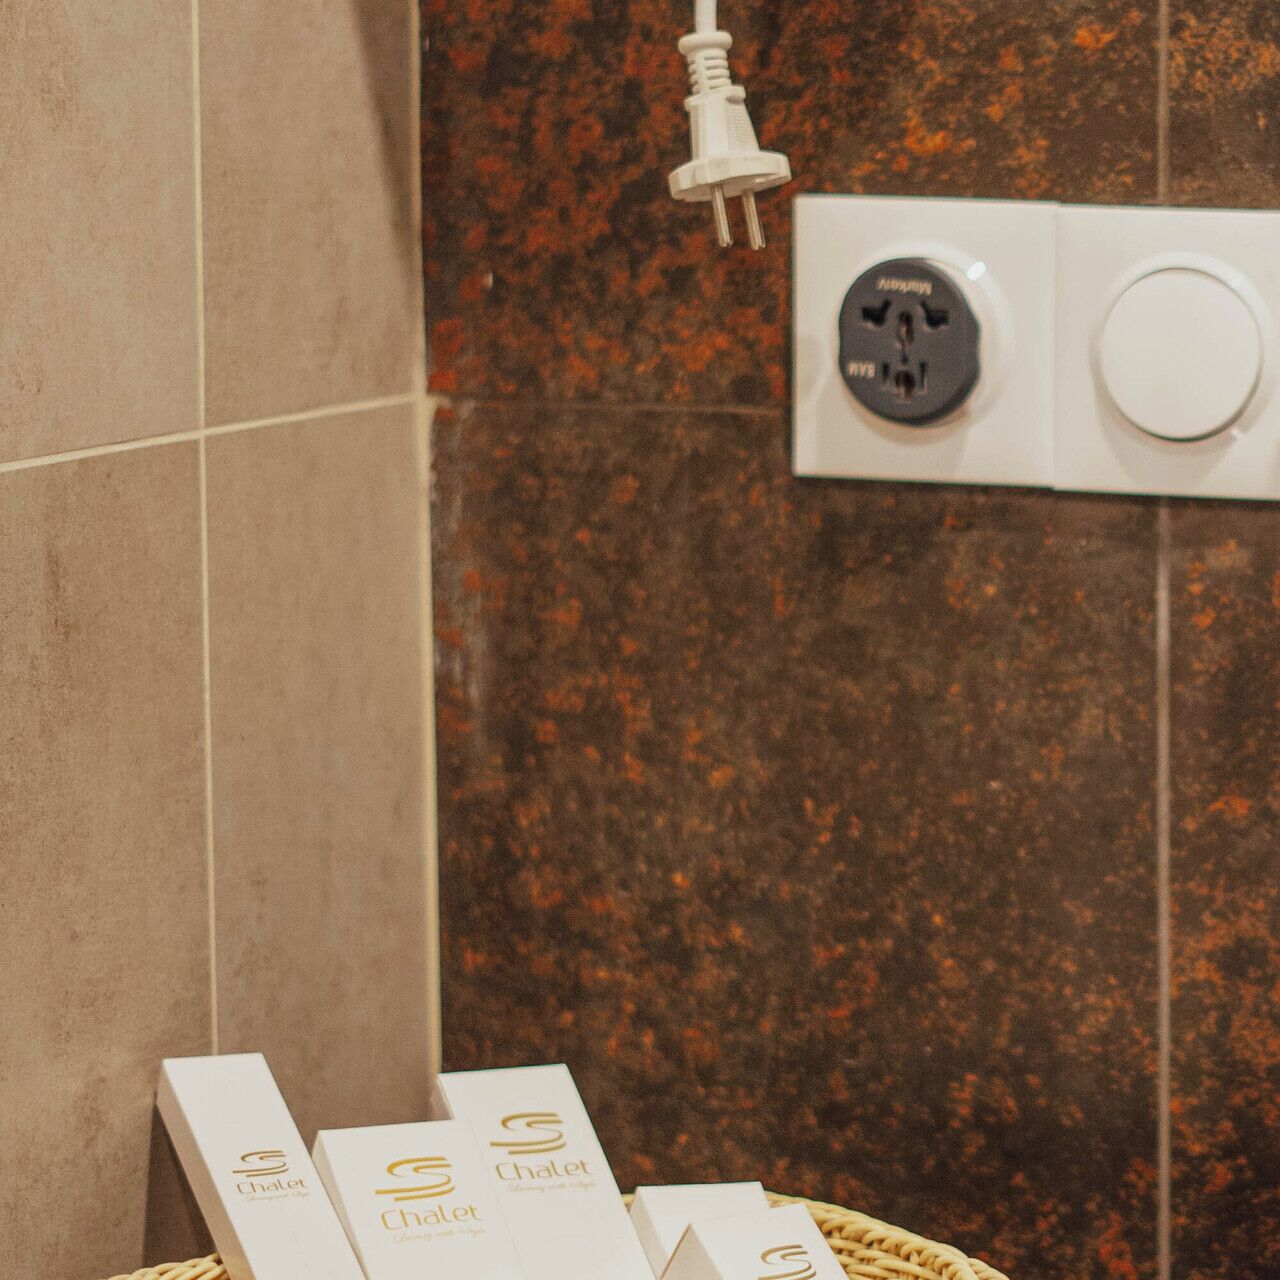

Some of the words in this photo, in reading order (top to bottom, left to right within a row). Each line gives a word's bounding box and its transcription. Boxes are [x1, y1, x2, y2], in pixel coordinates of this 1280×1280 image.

[495, 1159, 592, 1181] Chalet
[236, 1178, 309, 1194] Chalet
[381, 1204, 482, 1230] Chalet
